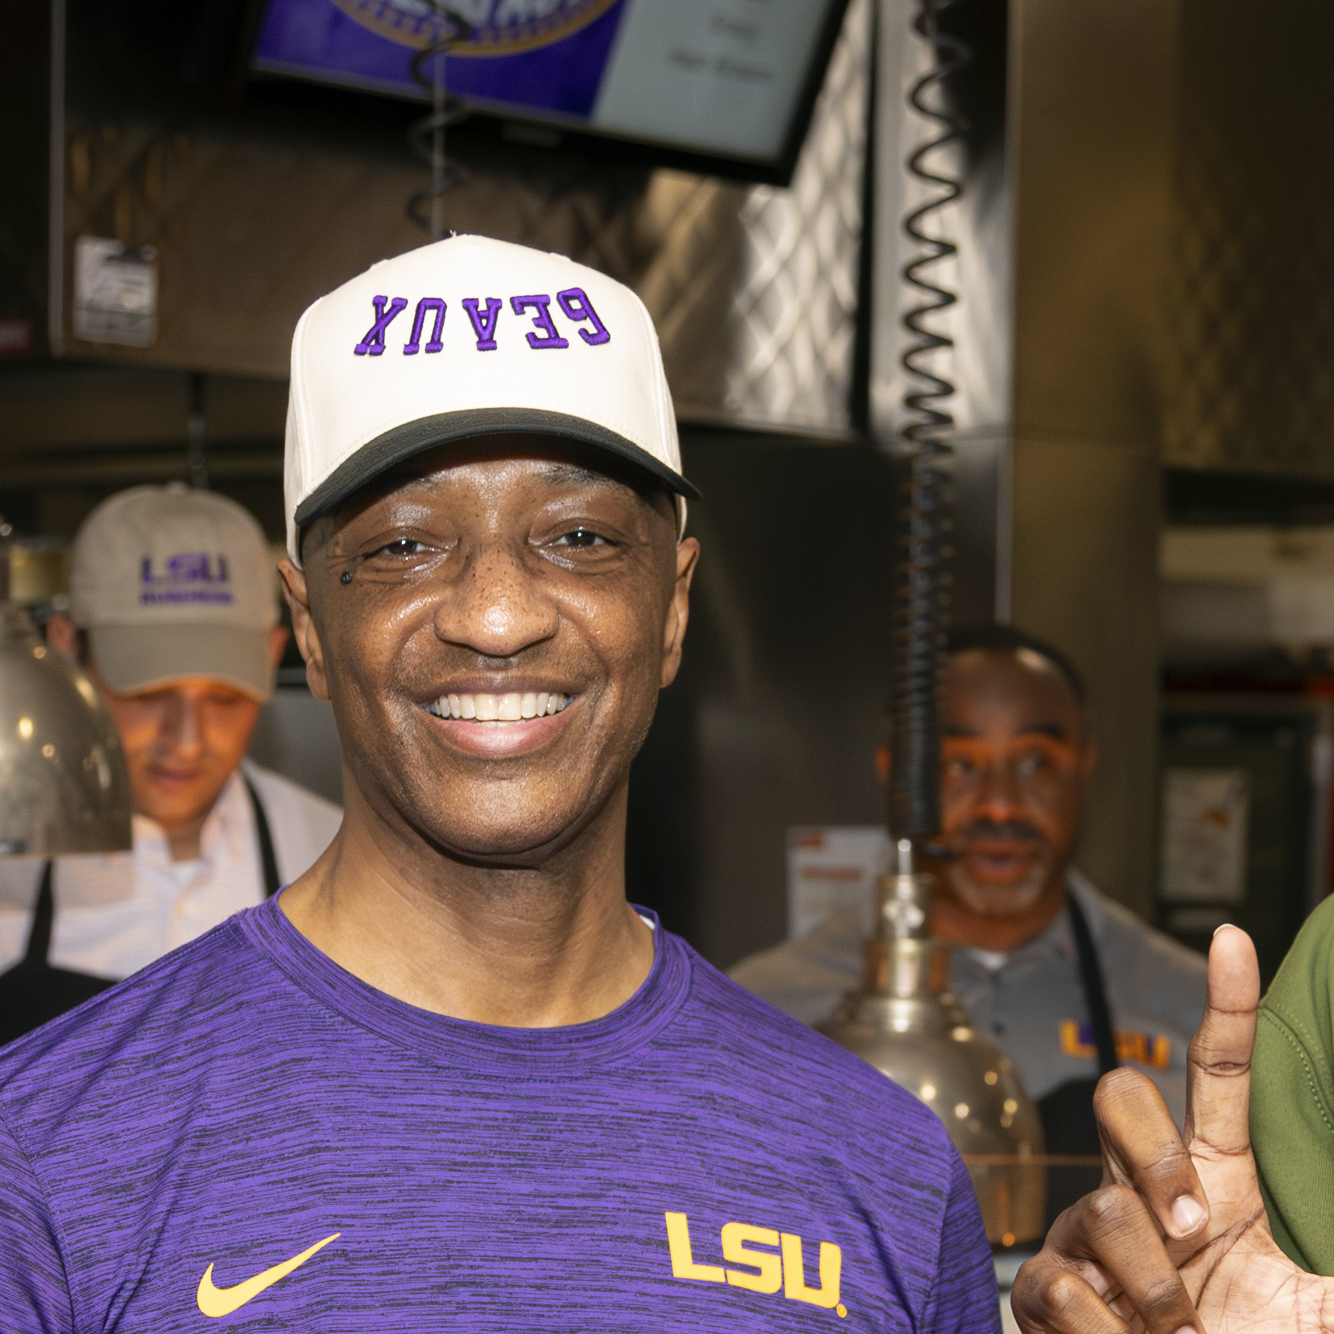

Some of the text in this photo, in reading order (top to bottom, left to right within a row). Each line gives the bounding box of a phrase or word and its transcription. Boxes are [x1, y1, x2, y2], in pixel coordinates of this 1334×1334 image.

[354, 287, 610, 356] GEAUX
[140, 552, 229, 583] LSU
[665, 1212, 843, 1310] LSU
